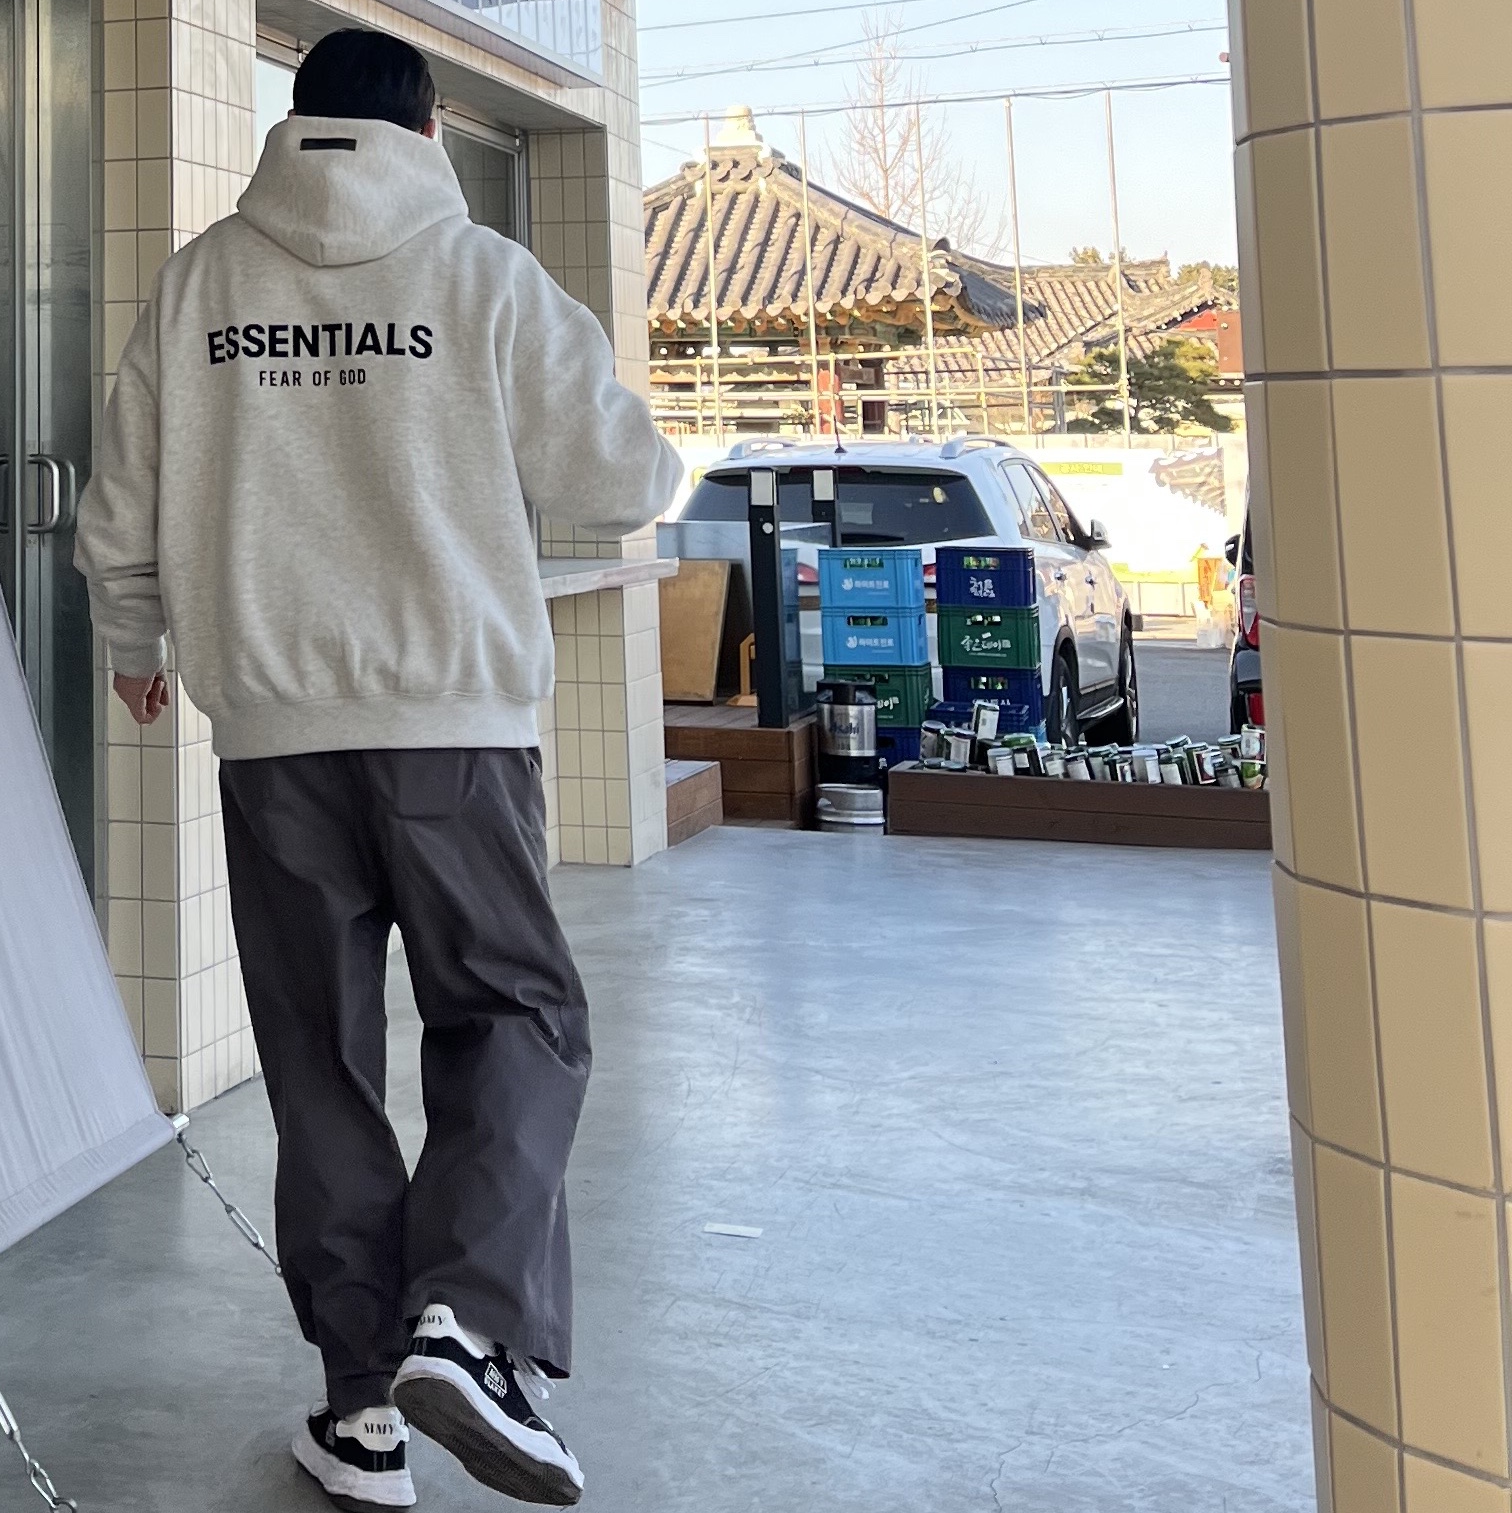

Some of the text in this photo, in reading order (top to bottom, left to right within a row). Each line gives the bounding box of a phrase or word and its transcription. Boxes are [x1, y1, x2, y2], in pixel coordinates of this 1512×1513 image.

[207, 322, 433, 365] ESSENTIALS
[259, 368, 366, 387] FEAR OF GOD
